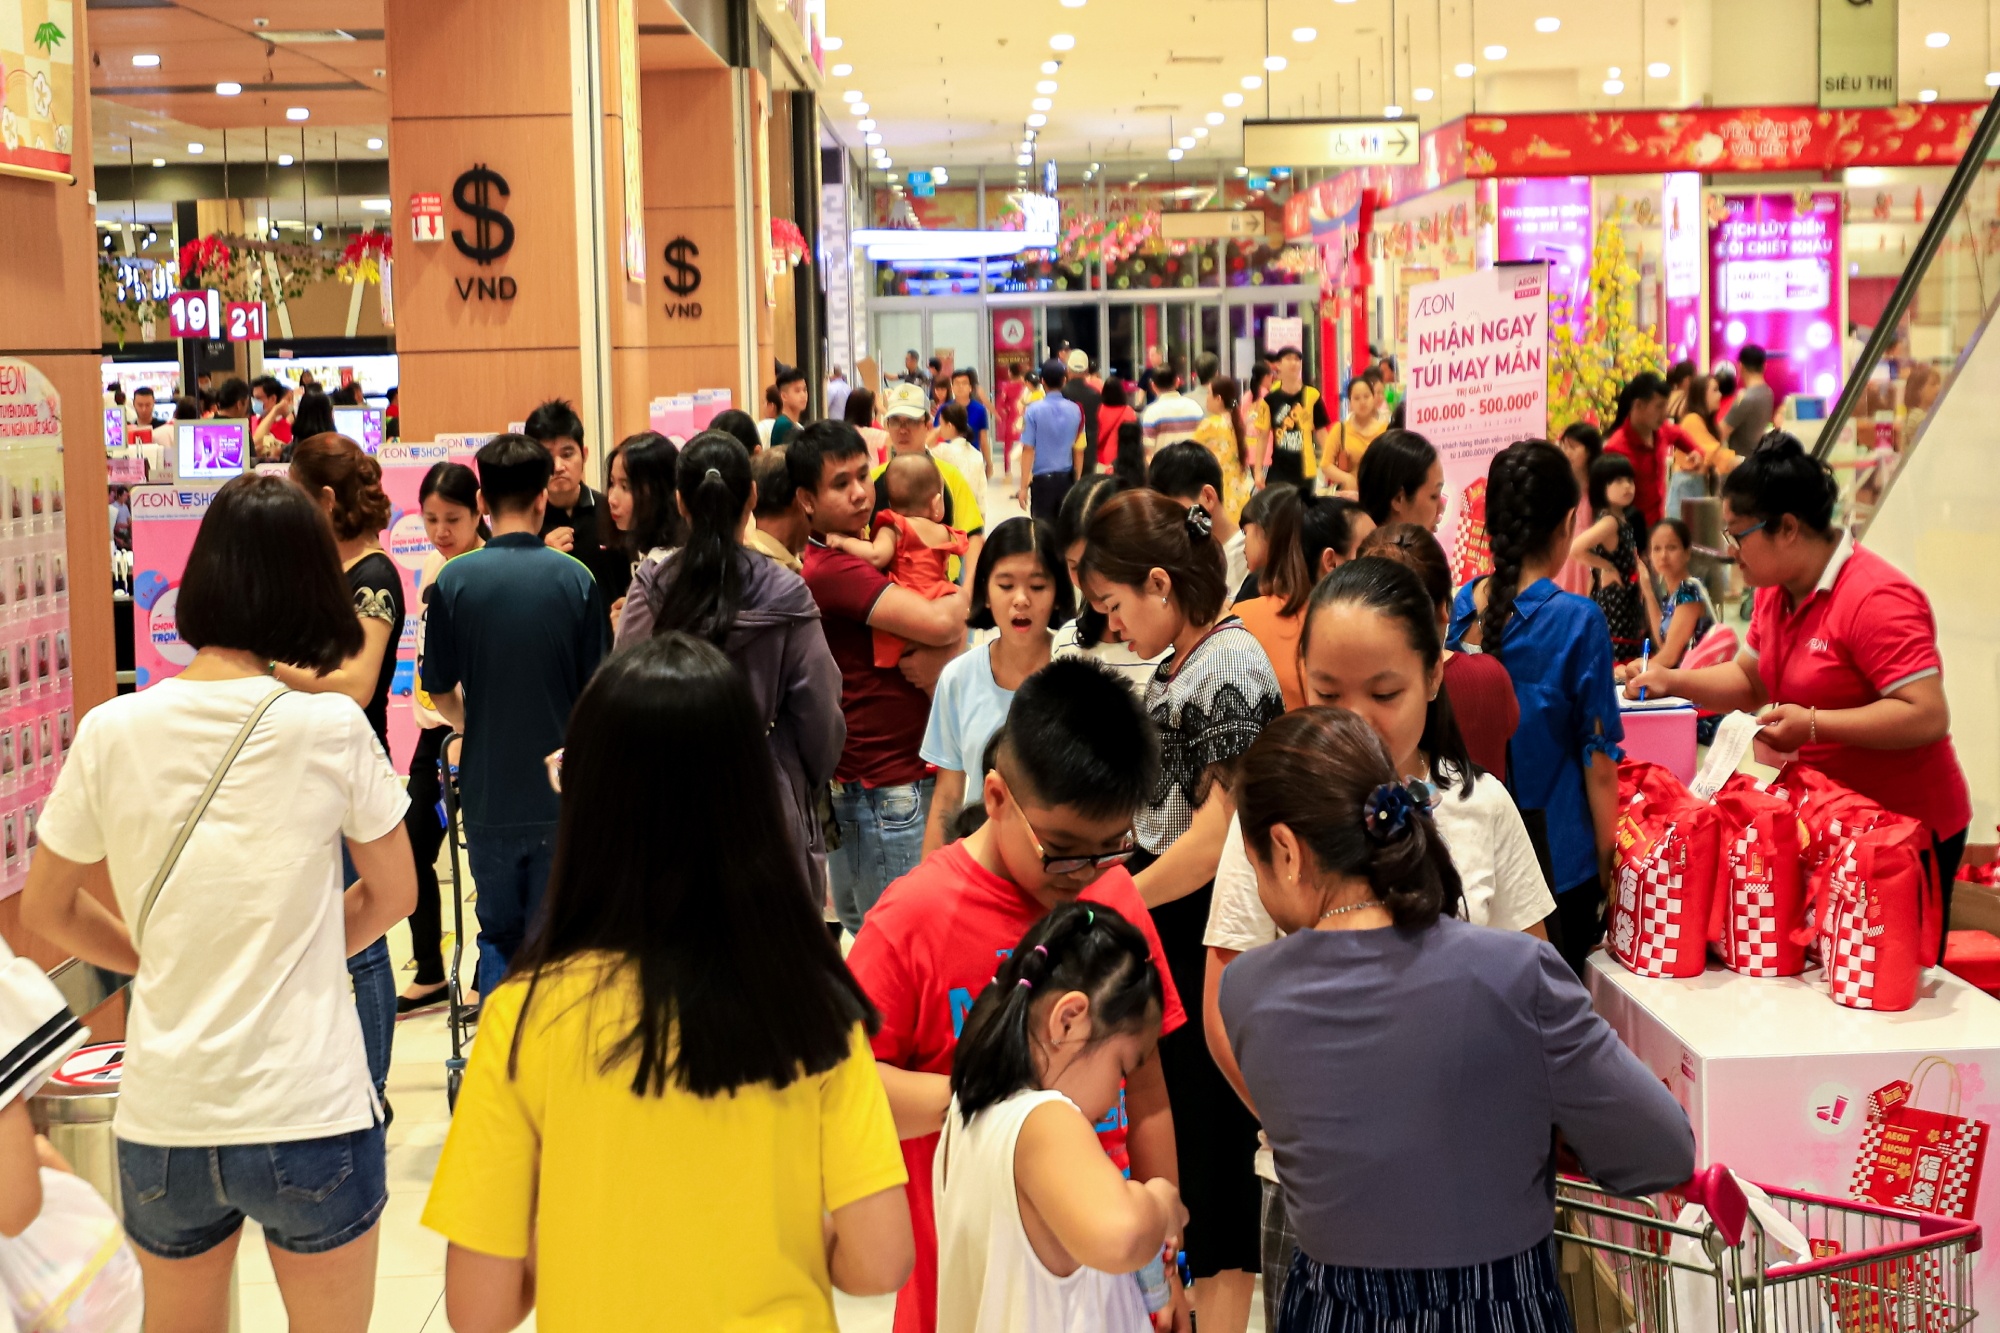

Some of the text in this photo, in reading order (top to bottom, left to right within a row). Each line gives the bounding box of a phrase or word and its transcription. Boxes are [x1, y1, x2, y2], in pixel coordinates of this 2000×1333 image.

[455, 277, 518, 302] VND
[171, 297, 207, 332] 19
[665, 303, 702, 318] VND
[230, 307, 260, 338] 21
[1007, 323, 1019, 338] A
[1419, 312, 1538, 356] NHẬN NGAY
[1413, 340, 1541, 389] TÚI MAY MẮN
[1416, 402, 1466, 424] 100.000
[152, 622, 175, 633] CHỌN
[152, 632, 177, 644] TRỌN
[1885, 1131, 1911, 1143] AEON
[1881, 1143, 1913, 1156] LUCKY
[1878, 1154, 1898, 1165] BAG
